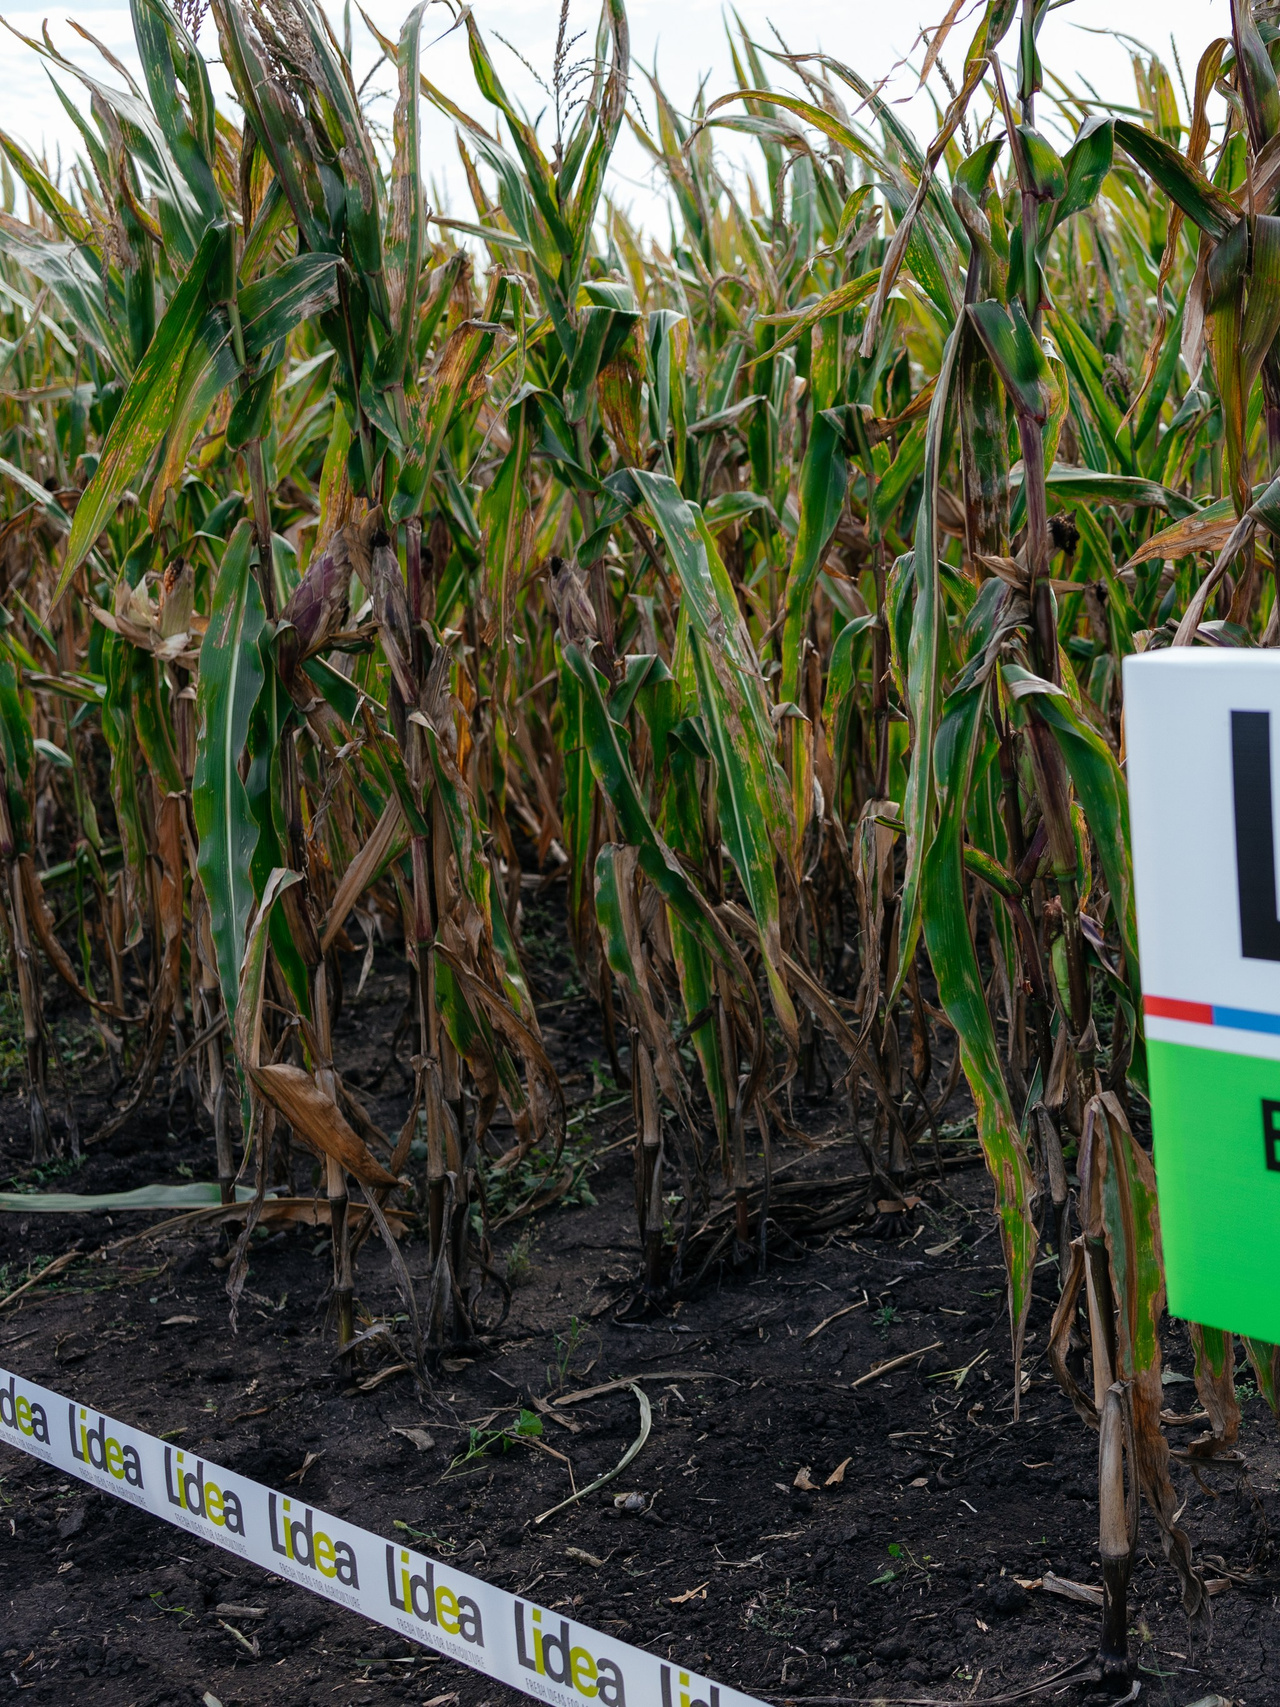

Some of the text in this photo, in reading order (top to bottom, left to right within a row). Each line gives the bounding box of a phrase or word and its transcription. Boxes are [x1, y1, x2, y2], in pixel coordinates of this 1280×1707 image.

[0, 1376, 51, 1446] dea
[69, 1403, 145, 1490] Lidea
[164, 1446, 246, 1538] Lidea
[268, 1492, 361, 1591] Lidea
[386, 1543, 486, 1649] Lidea
[514, 1599, 626, 1707] Lidea
